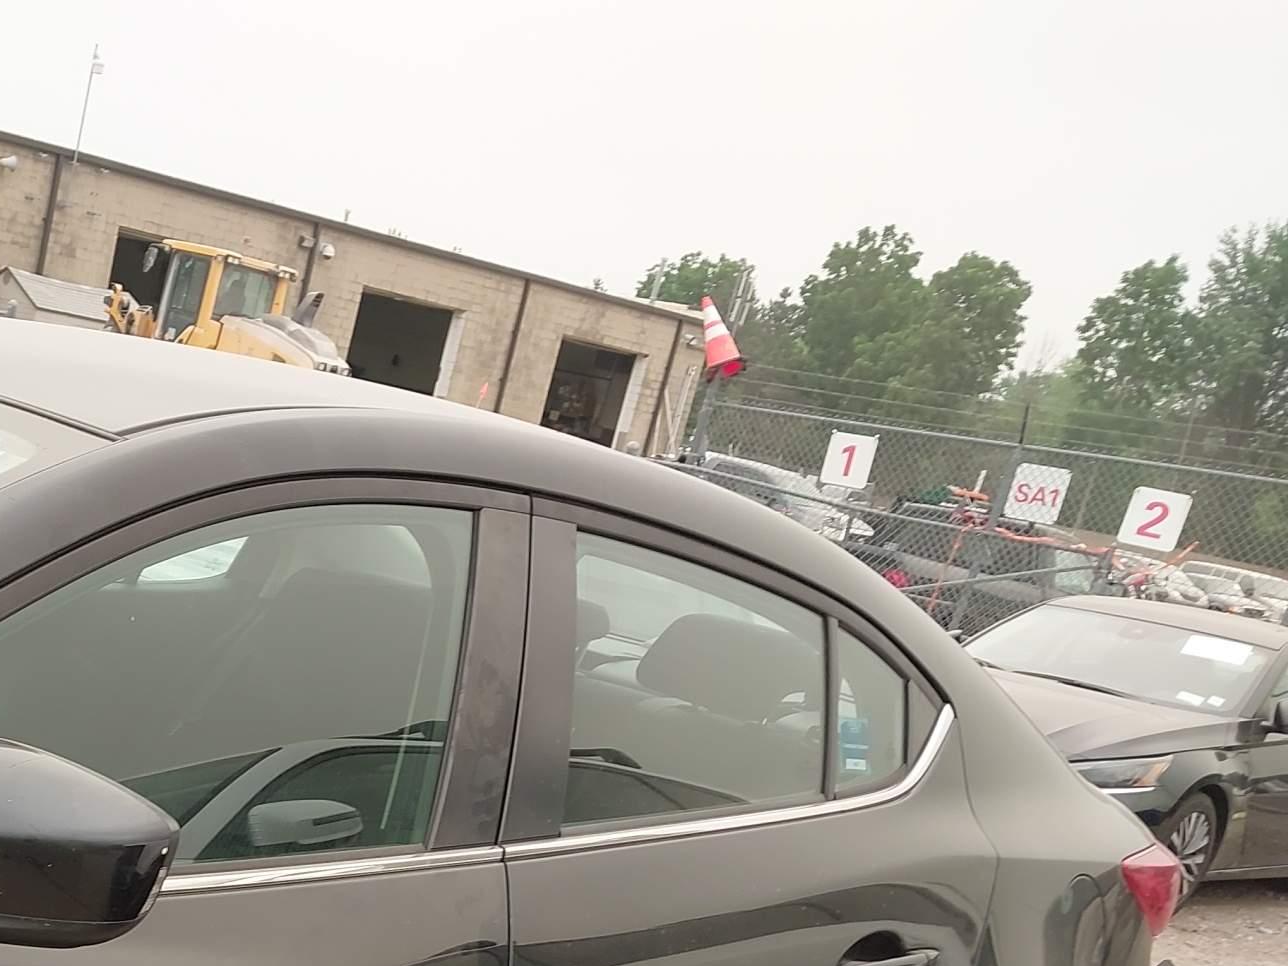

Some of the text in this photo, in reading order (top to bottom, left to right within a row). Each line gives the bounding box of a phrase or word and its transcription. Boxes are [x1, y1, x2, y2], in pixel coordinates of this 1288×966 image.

[840, 444, 857, 477] 1
[1014, 483, 1061, 509] SA1
[1136, 500, 1170, 539] 2
